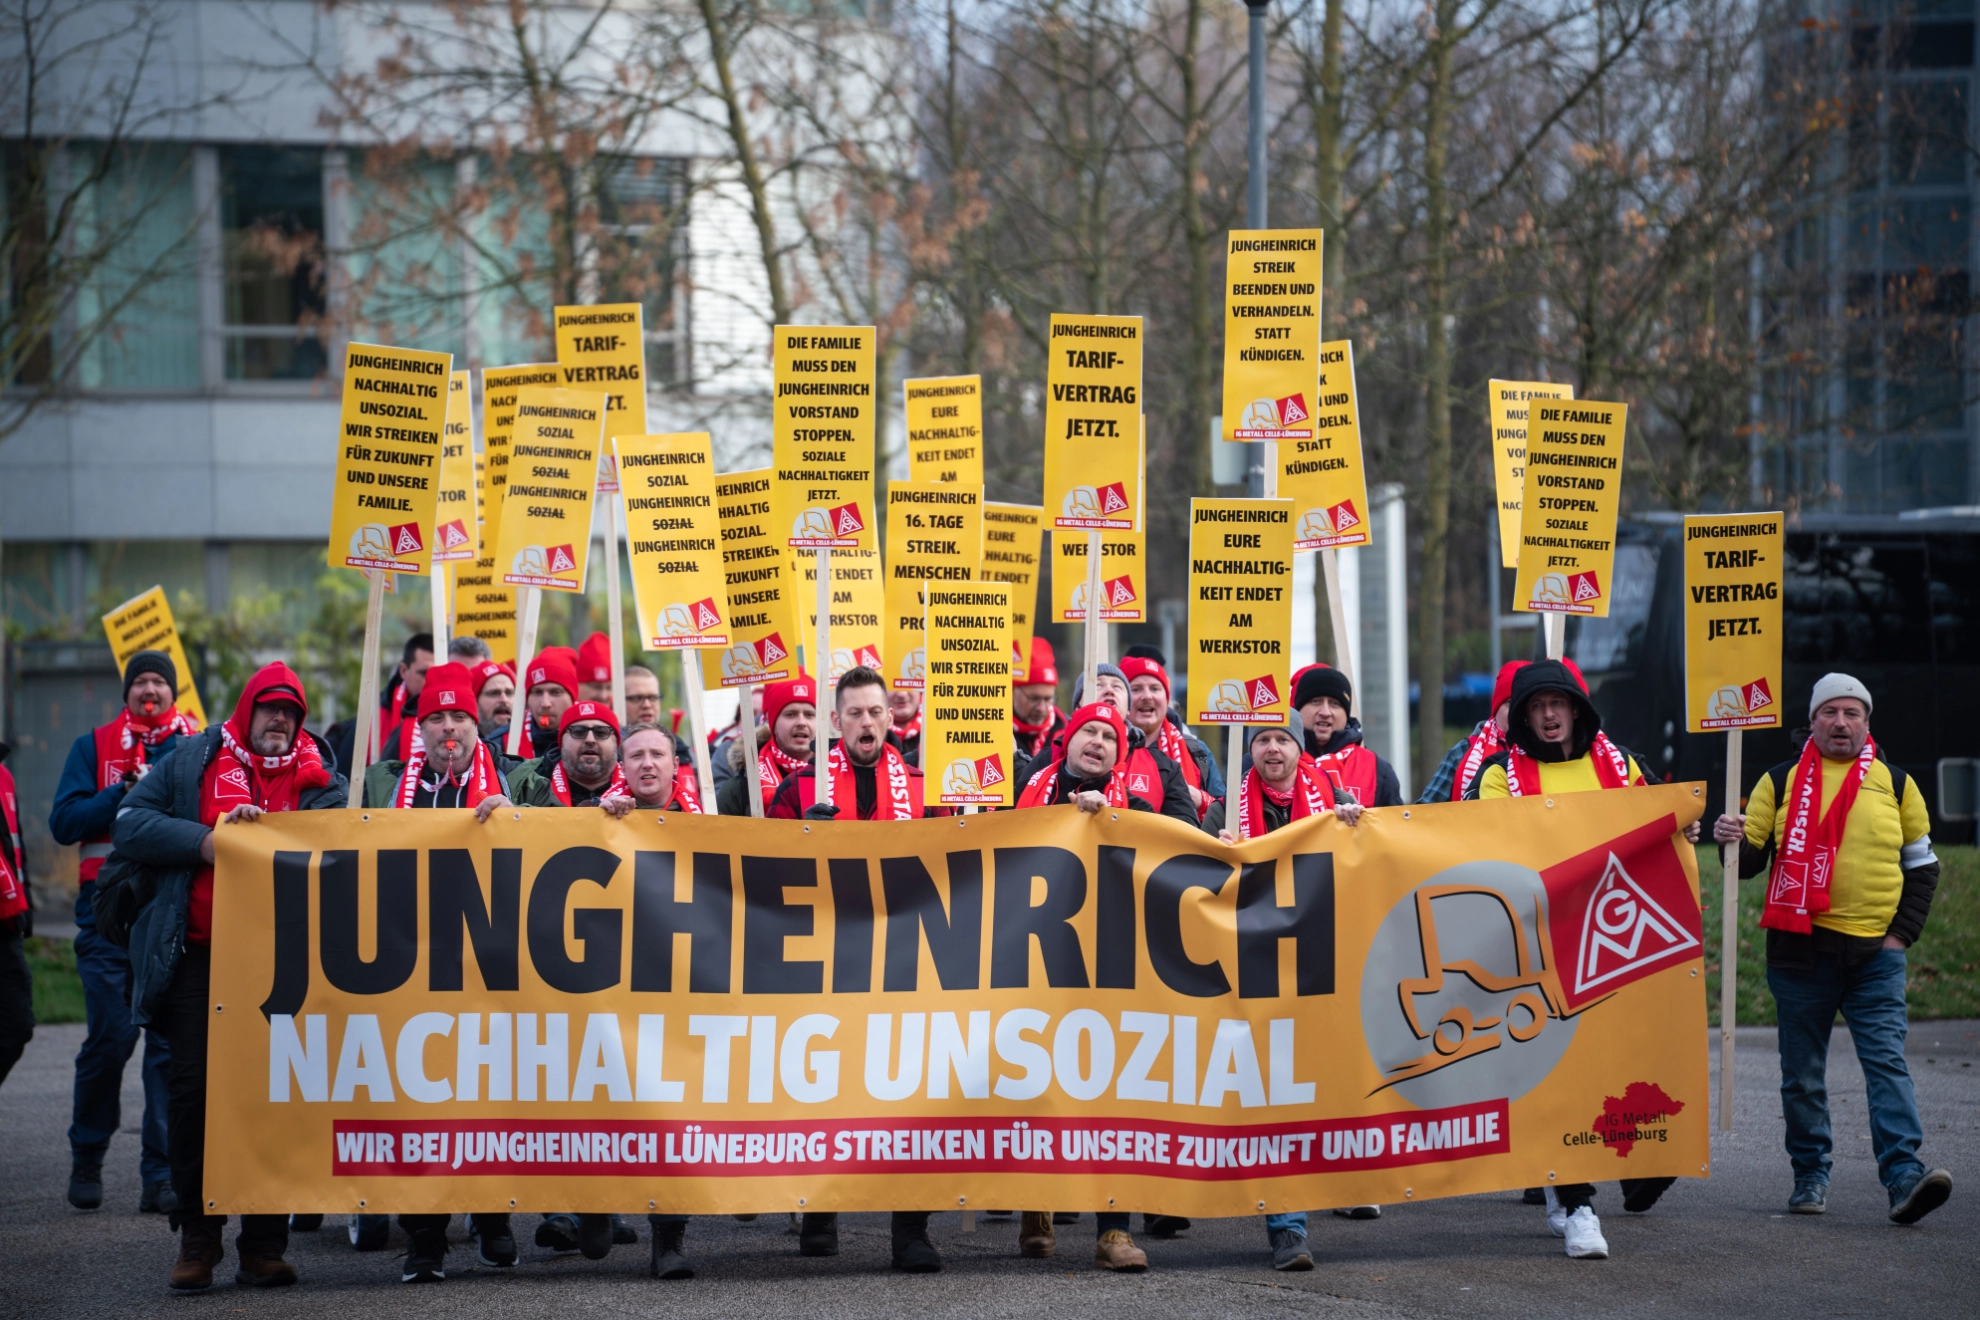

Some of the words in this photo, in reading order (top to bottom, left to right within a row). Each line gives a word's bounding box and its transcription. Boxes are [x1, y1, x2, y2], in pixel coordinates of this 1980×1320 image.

[1231, 239, 1316, 254] JUNGHEINRICH
[1253, 262, 1295, 273] STREIK
[1233, 284, 1287, 295] BEENDEN
[1290, 283, 1315, 295] UND
[1232, 306, 1314, 317] VERHANDELN.
[558, 312, 636, 327] JUNGHEINRICH
[1053, 324, 1136, 338] JUNGHEINRICH
[1255, 328, 1291, 339] STATT
[573, 336, 626, 352] TARIF-
[788, 337, 808, 349] DIE
[811, 338, 861, 350] FAMILIE
[1066, 350, 1124, 369] TARIF-
[1240, 347, 1305, 361] KÜNDIGEN.
[349, 354, 443, 375] JUNGHEINRICH
[792, 360, 828, 372] MUSS
[831, 360, 856, 373] DEN
[564, 364, 640, 382] VERTRAG
[355, 378, 437, 398] NACHHALTIG
[486, 372, 557, 390] JUNGHEINRICH
[779, 383, 869, 397] JUNGHEINRICH
[908, 385, 975, 400] JUNGHEINRICH
[1053, 384, 1136, 404] VERTRAG
[1501, 390, 1518, 400] DIE
[1325, 393, 1349, 407] UND
[360, 402, 428, 420] UNSOZIAL.
[519, 405, 596, 421] JUNGHEINRICH
[789, 406, 859, 418] VORSTAND
[932, 406, 959, 418] EURE
[1540, 408, 1560, 421] DIE
[1563, 410, 1612, 425] FAMILIE
[346, 424, 372, 438] WIR
[375, 427, 438, 444] STREIKEN
[537, 426, 575, 439] SOZIAL
[793, 429, 855, 442] STOPPEN.
[910, 426, 980, 441] NACHHALTIG-
[1066, 419, 1120, 439] JETZT.
[1265, 430, 1311, 438] CELLE-LÜNEBURG
[488, 436, 507, 447] WIR
[1297, 438, 1332, 452] STATT
[1542, 431, 1578, 445] MUSS
[1580, 433, 1606, 446] DEN
[346, 445, 371, 461] FÜR
[374, 450, 434, 467] ZUKUNFT
[514, 445, 592, 461] JUNGHEINRICH
[802, 451, 846, 462] SOZIALE
[917, 450, 941, 462] KEIT
[944, 448, 975, 461] ENDET
[490, 455, 509, 466] FÜR
[623, 453, 705, 468] JUNGHEINRICH
[1285, 458, 1348, 475] KÜNDIGEN.
[1529, 452, 1617, 469] JUNGHEINRICH
[532, 466, 570, 479] SOZIAL
[778, 470, 869, 481] NACHHALTIGKEIT
[940, 471, 957, 482] AM
[347, 470, 375, 484] UND
[378, 474, 428, 490] UNSERE
[647, 474, 689, 488] SOZIAL
[1537, 475, 1605, 491] VORSTAND
[509, 485, 587, 501] JUNGHEINRICH
[808, 489, 840, 501] JETZT.
[890, 491, 976, 504] JUNGHEINRICH
[358, 495, 413, 512] FAMILIE.
[628, 496, 710, 511] JUNGHEINRICH
[1539, 497, 1599, 512] STOPPEN.
[527, 506, 566, 519] SOZIAL
[1195, 509, 1288, 523] JUNGHEINRICH
[652, 518, 694, 530] SOZIAL
[905, 514, 925, 527] 16.
[929, 515, 964, 528] TAGE
[1064, 518, 1084, 526] METALL
[1545, 519, 1588, 531] SOZIALE
[988, 530, 1016, 542] EURE
[1688, 523, 1777, 541] JUNGHEINRICH
[634, 539, 715, 554] JUNGHEINRICH
[907, 540, 961, 554] STREIK.
[1224, 534, 1261, 548] EURE
[1524, 536, 1610, 551] NACHHALTIGKEIT
[722, 545, 780, 563] STREIKEN
[1704, 549, 1765, 569] TARIF-
[658, 561, 699, 574] SOZIAL
[1193, 560, 1291, 574] NACHHALTIG-
[1548, 555, 1580, 568] JETZT.
[726, 567, 780, 585] ZUKUNFT
[836, 568, 873, 580] ENDET
[894, 565, 971, 580] MENSCHEN
[994, 572, 1030, 584] ENDET
[734, 589, 780, 606] UNSERE
[833, 591, 852, 603] AM
[929, 592, 1007, 606] JUNGHEINRICH
[1200, 587, 1233, 600] KEIT
[1236, 587, 1283, 601] ENDET
[1691, 582, 1777, 603] VERTRAG
[935, 615, 1004, 629] NACHHALTIG
[1229, 614, 1253, 627] AM
[1708, 617, 1762, 641] JETZT.
[941, 638, 999, 652] UNSOZIAL.
[1200, 639, 1281, 654] WERKSTOR
[931, 662, 953, 675] WIR
[955, 662, 1008, 675] STREIKEN
[933, 683, 954, 697] FÜR
[957, 685, 1006, 697] ZUKUNFT
[935, 708, 959, 720] UND
[961, 708, 1004, 721] UNSERE
[1232, 713, 1282, 721] CELLE-LÜNEBURG
[1709, 719, 1730, 727] METALL
[1731, 716, 1775, 725] CELLE-LÜNEBURG
[946, 731, 994, 744] FAMILIE.
[259, 845, 1336, 1024] JUNGHEINRICH
[269, 1012, 840, 1104] NACHHALTIG
[864, 1008, 1317, 1108] UNSOZIAL
[1604, 1114, 1618, 1127] IG
[1622, 1110, 1667, 1126] Metall
[336, 1132, 395, 1164] WIR
[401, 1132, 448, 1163] BEI
[452, 1131, 657, 1170] JUNGHEINRICH
[665, 1124, 826, 1164] LÜNEBURG
[833, 1129, 986, 1161] STREIKEN
[992, 1121, 1054, 1161] FÜR
[1061, 1129, 1170, 1164] UNSERE
[1176, 1132, 1316, 1168] ZUKUNFT
[1322, 1126, 1385, 1161] UND
[1391, 1111, 1500, 1155] FAMILIE
[1563, 1126, 1668, 1147] Celle-Lüneburg
